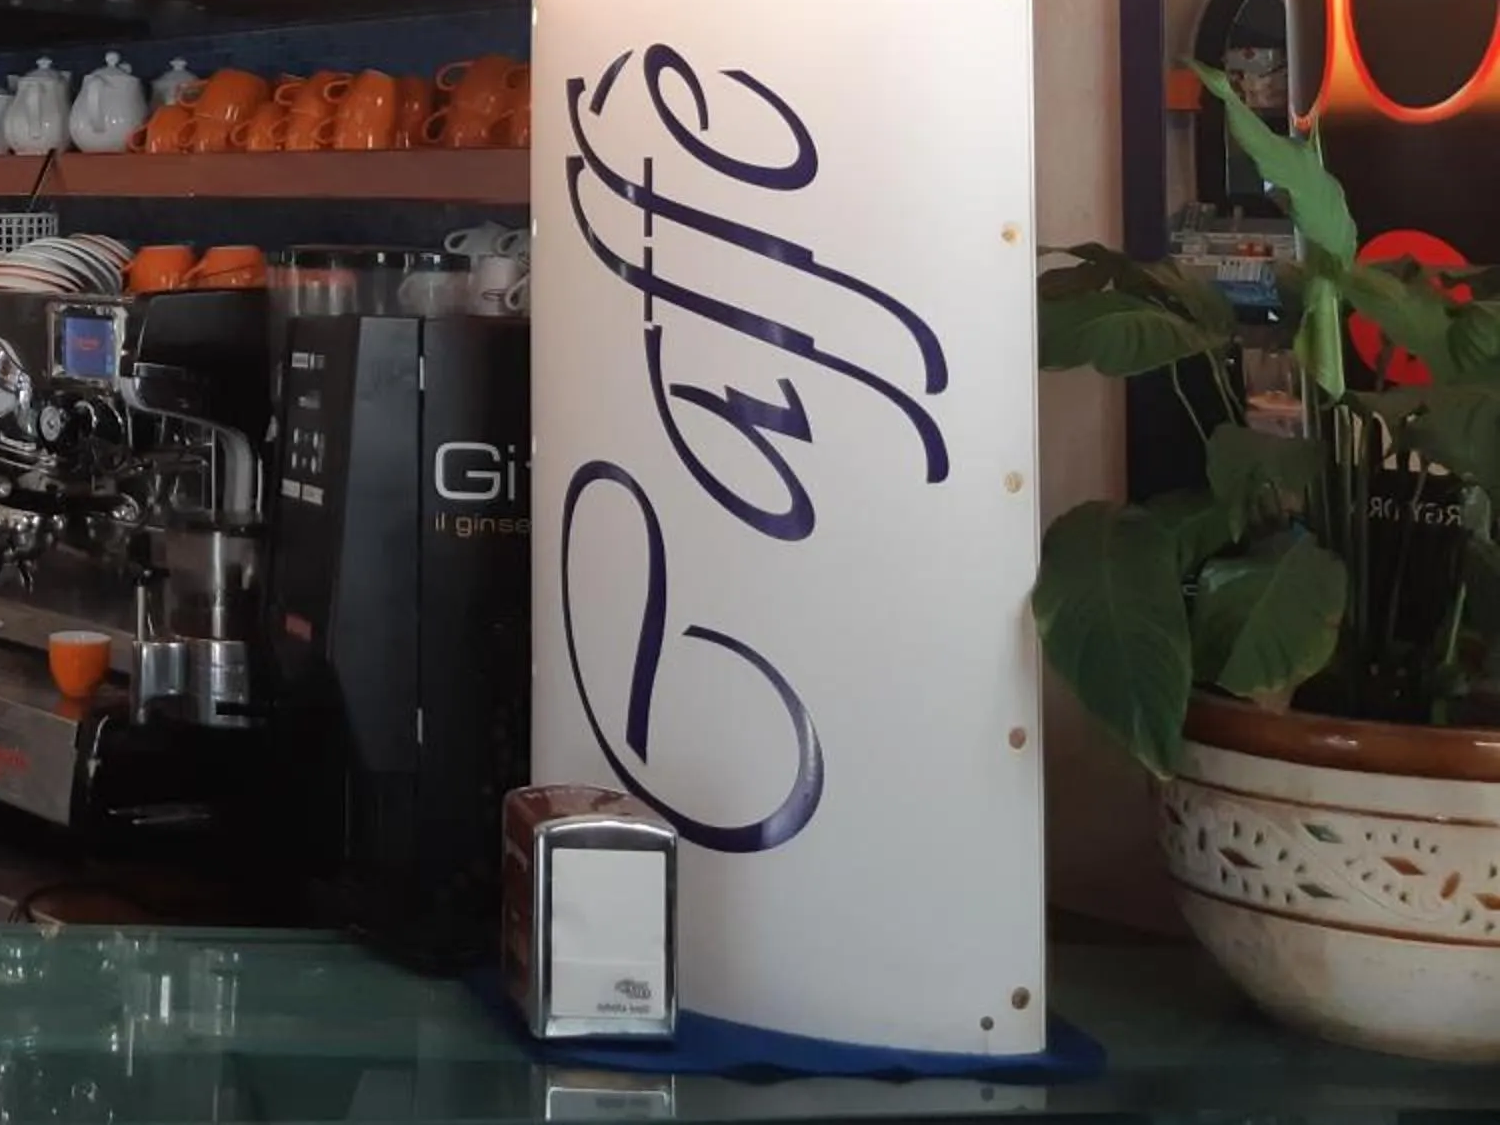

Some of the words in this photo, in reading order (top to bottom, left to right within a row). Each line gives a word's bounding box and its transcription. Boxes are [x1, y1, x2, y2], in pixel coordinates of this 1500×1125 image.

[434, 441, 531, 501] Gi
[560, 42, 949, 855] Caffè
[455, 512, 531, 538] ginse
